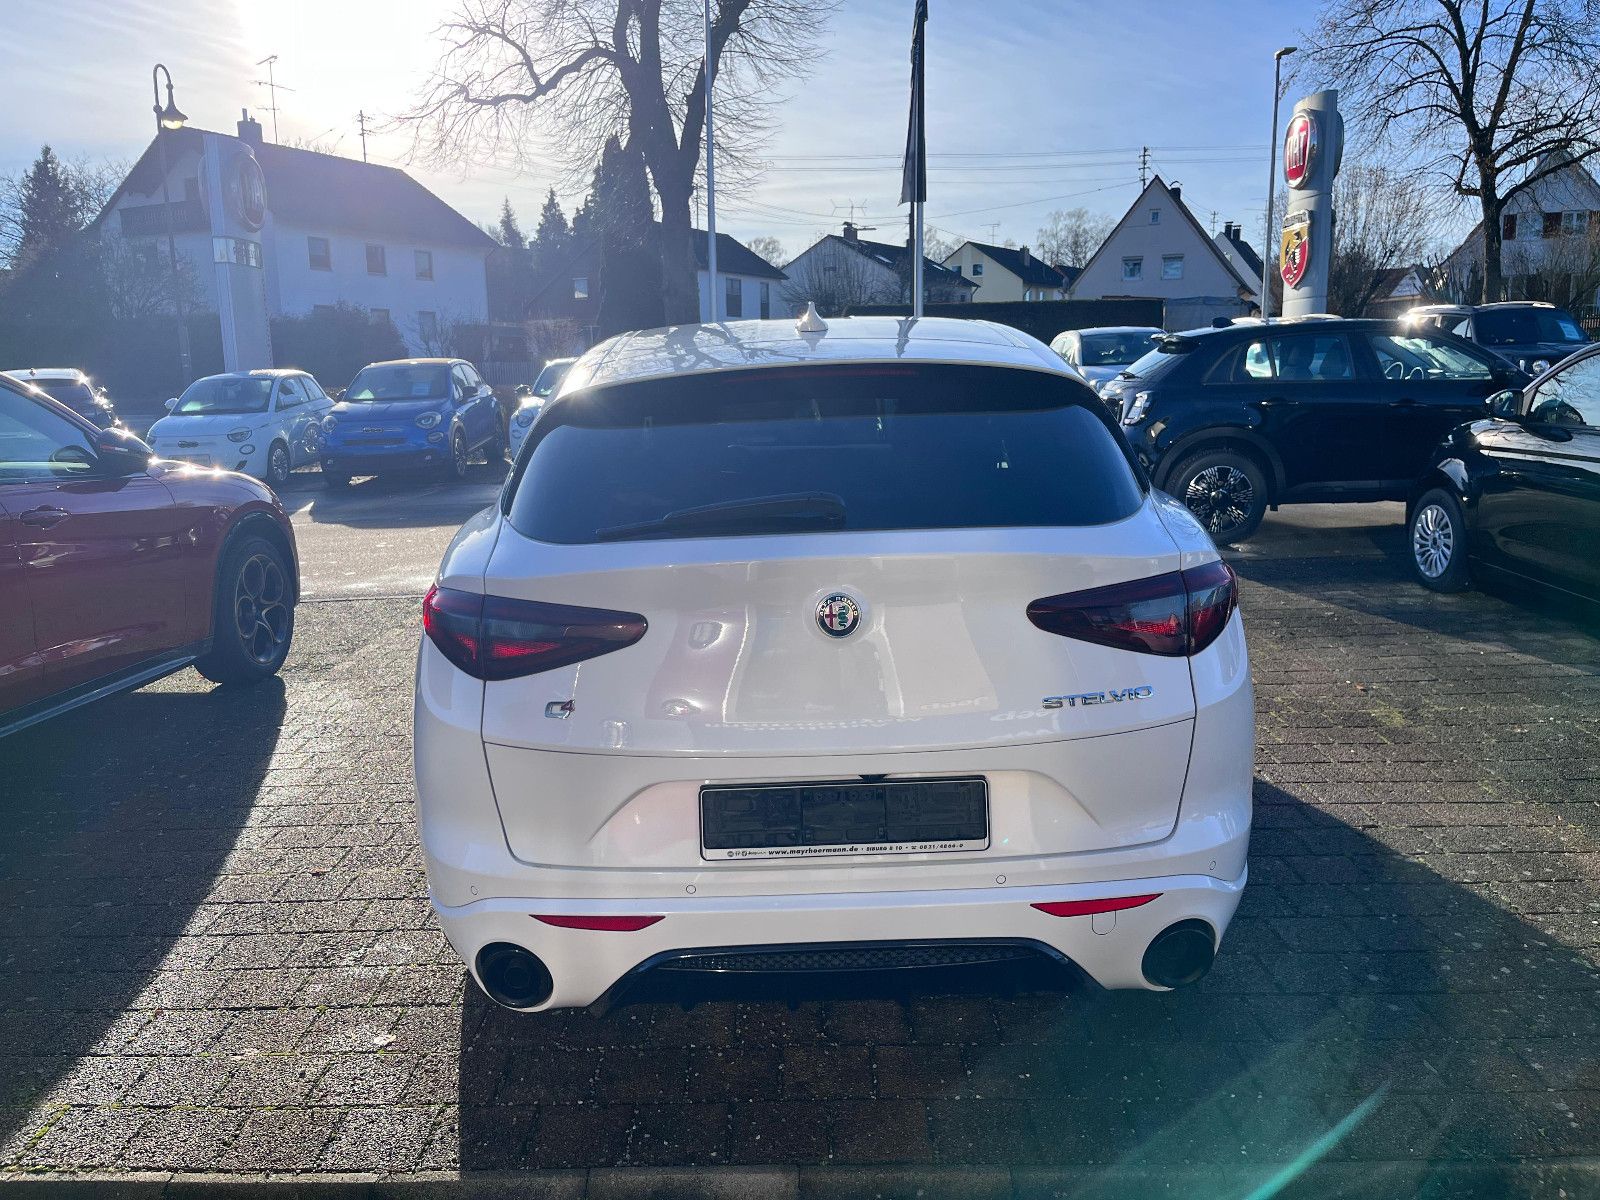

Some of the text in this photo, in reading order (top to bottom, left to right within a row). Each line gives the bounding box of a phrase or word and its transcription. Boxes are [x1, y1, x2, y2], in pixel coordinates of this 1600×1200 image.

[835, 596, 858, 616] ROMEO
[1042, 685, 1154, 709] STELVIO
[544, 699, 576, 719] Q4
[768, 845, 859, 857] www.mayrhoermann.de
